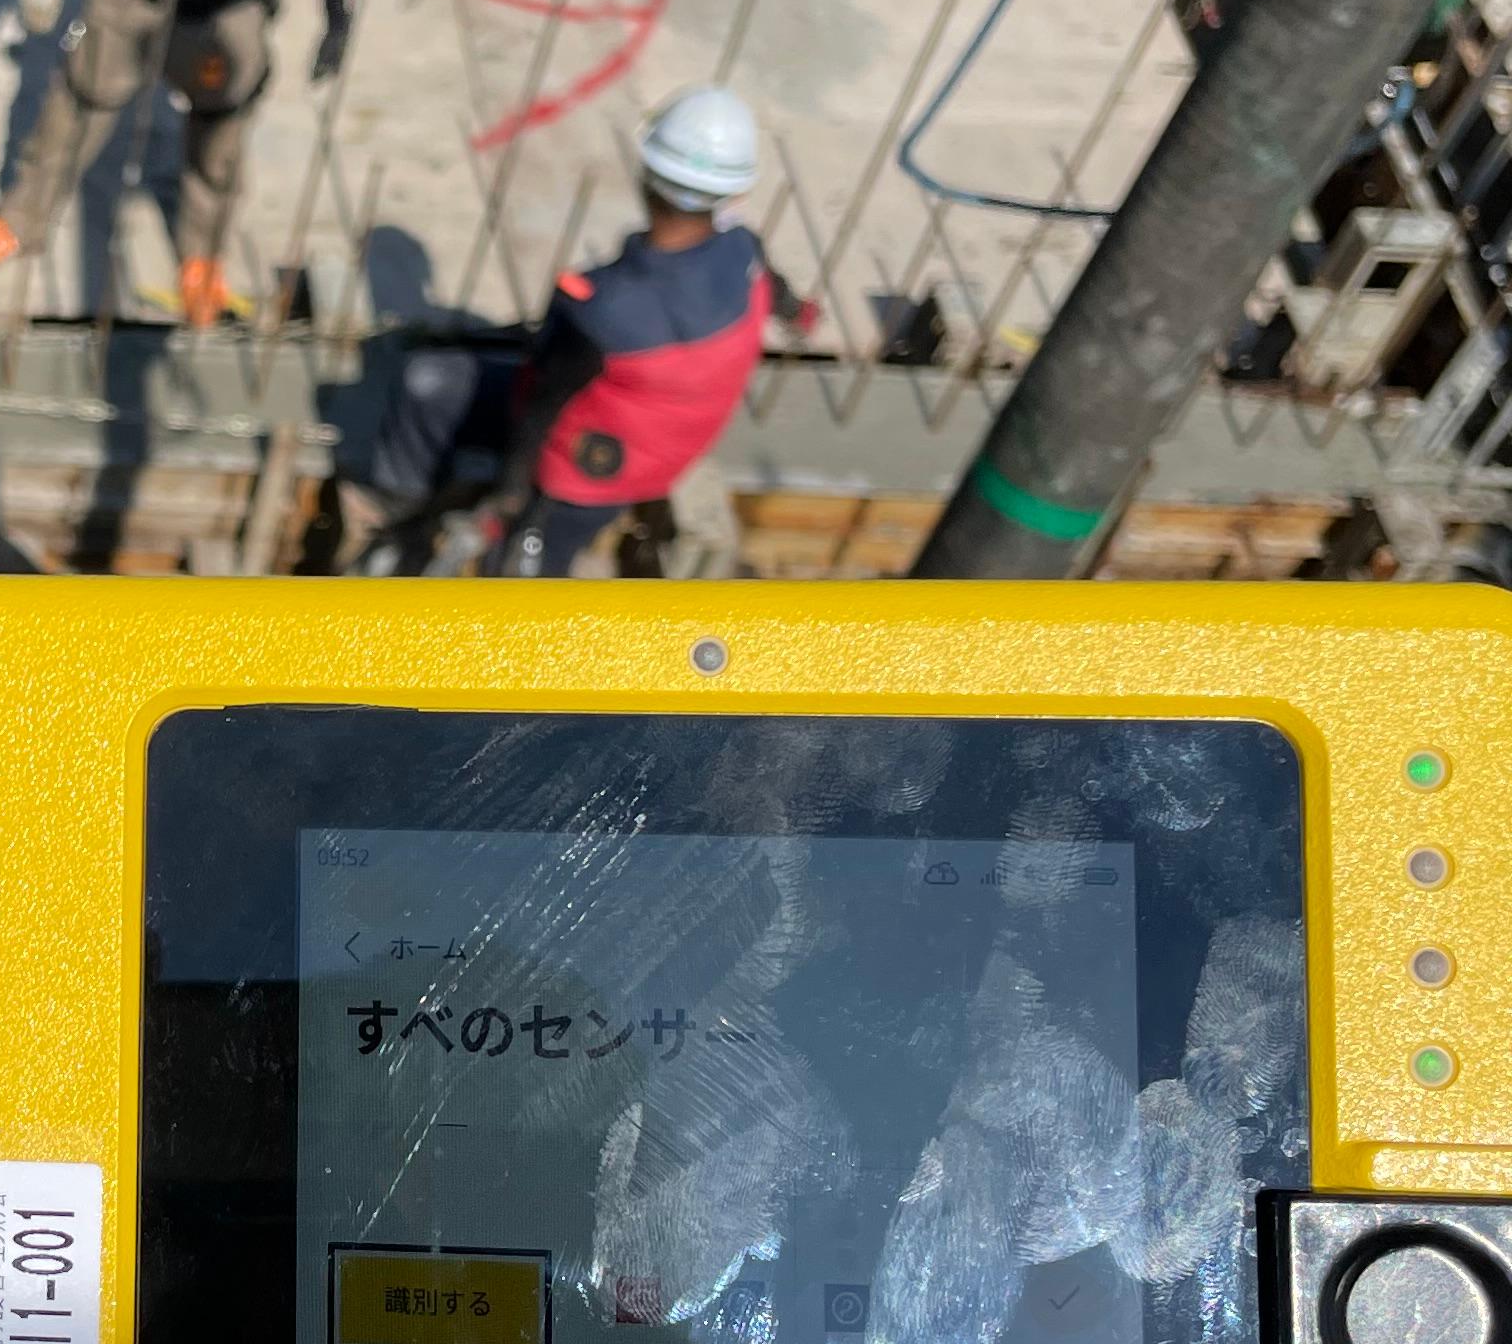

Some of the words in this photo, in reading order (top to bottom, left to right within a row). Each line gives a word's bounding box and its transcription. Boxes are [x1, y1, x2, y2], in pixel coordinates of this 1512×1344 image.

[318, 847, 370, 867] 09:52
[390, 935, 468, 961] ホーム
[346, 999, 757, 1061] すべのセンサー
[383, 1286, 491, 1317] 識別する
